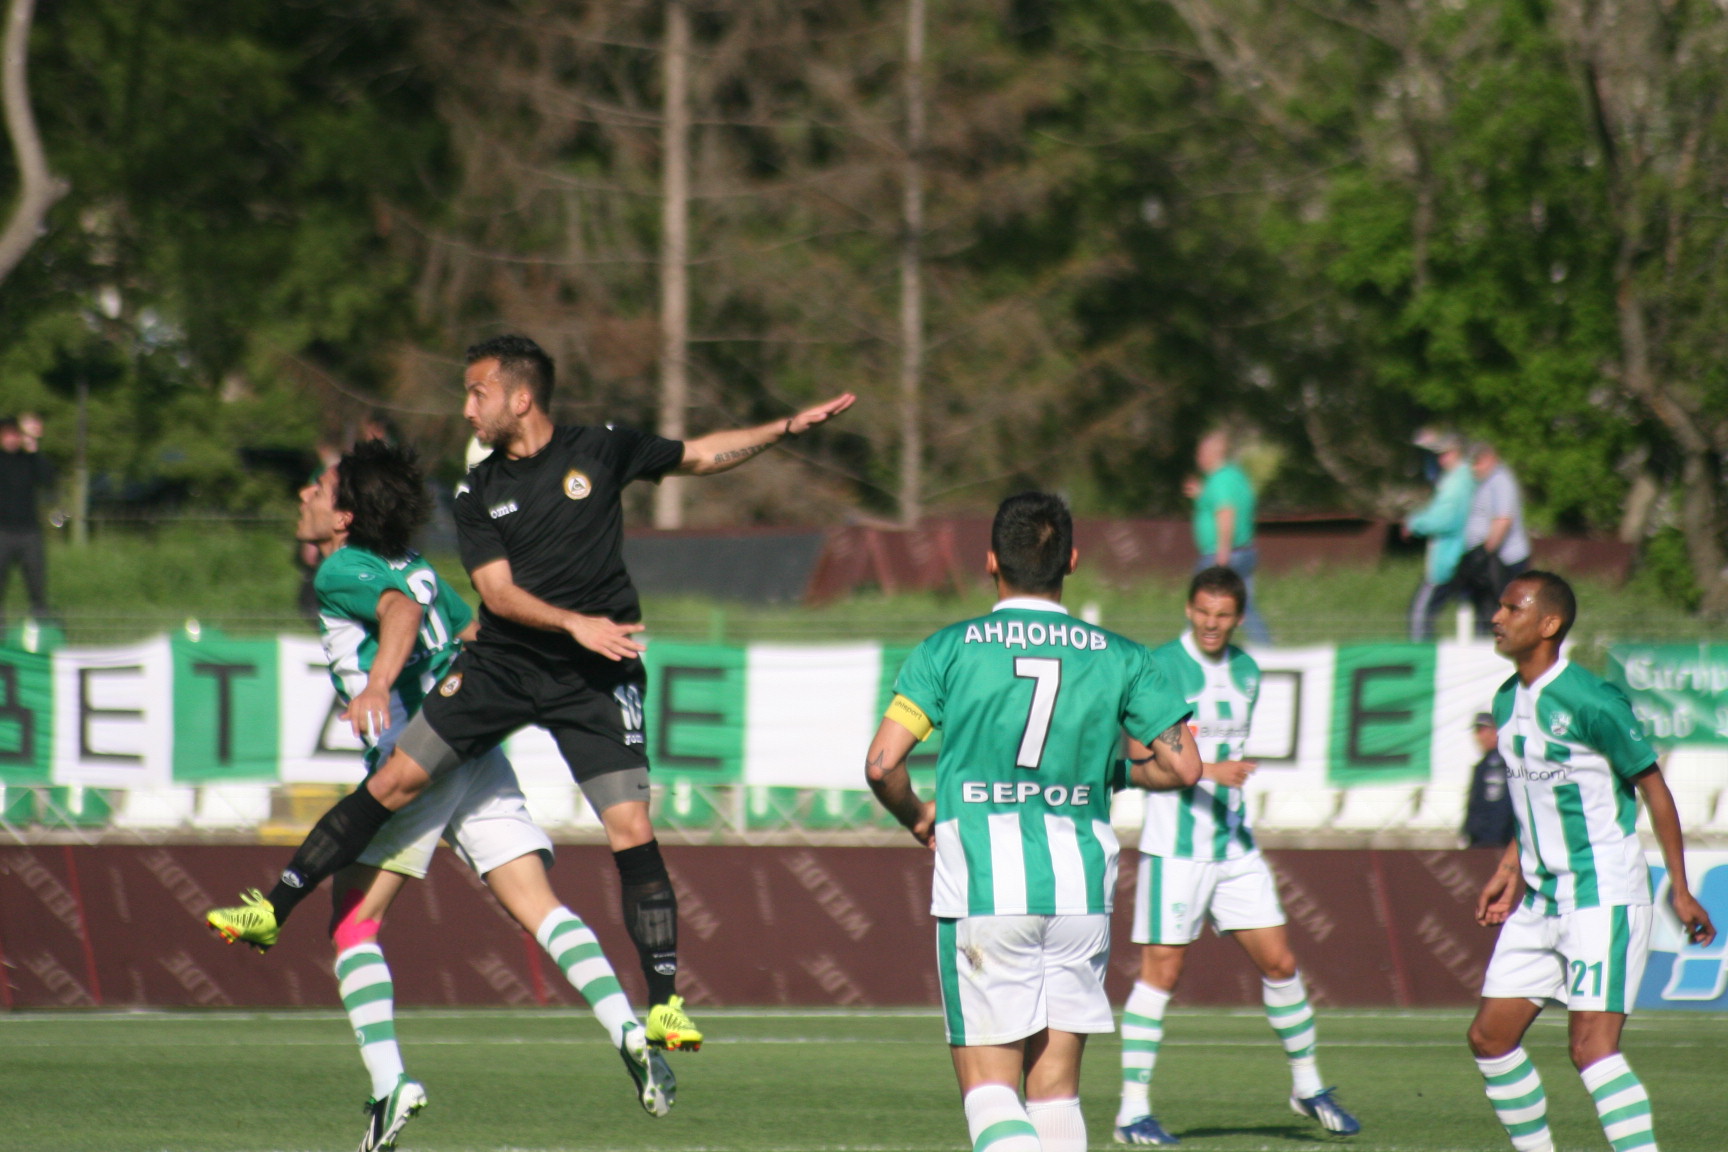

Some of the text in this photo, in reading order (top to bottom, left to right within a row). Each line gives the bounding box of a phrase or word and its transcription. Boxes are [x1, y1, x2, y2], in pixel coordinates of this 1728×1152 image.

[489, 500, 518, 520] oma
[964, 621, 1107, 650] АНДОНОВ
[1013, 656, 1062, 770] 7
[962, 782, 1091, 807] БЕРОЕ
[1570, 959, 1603, 998] 21
